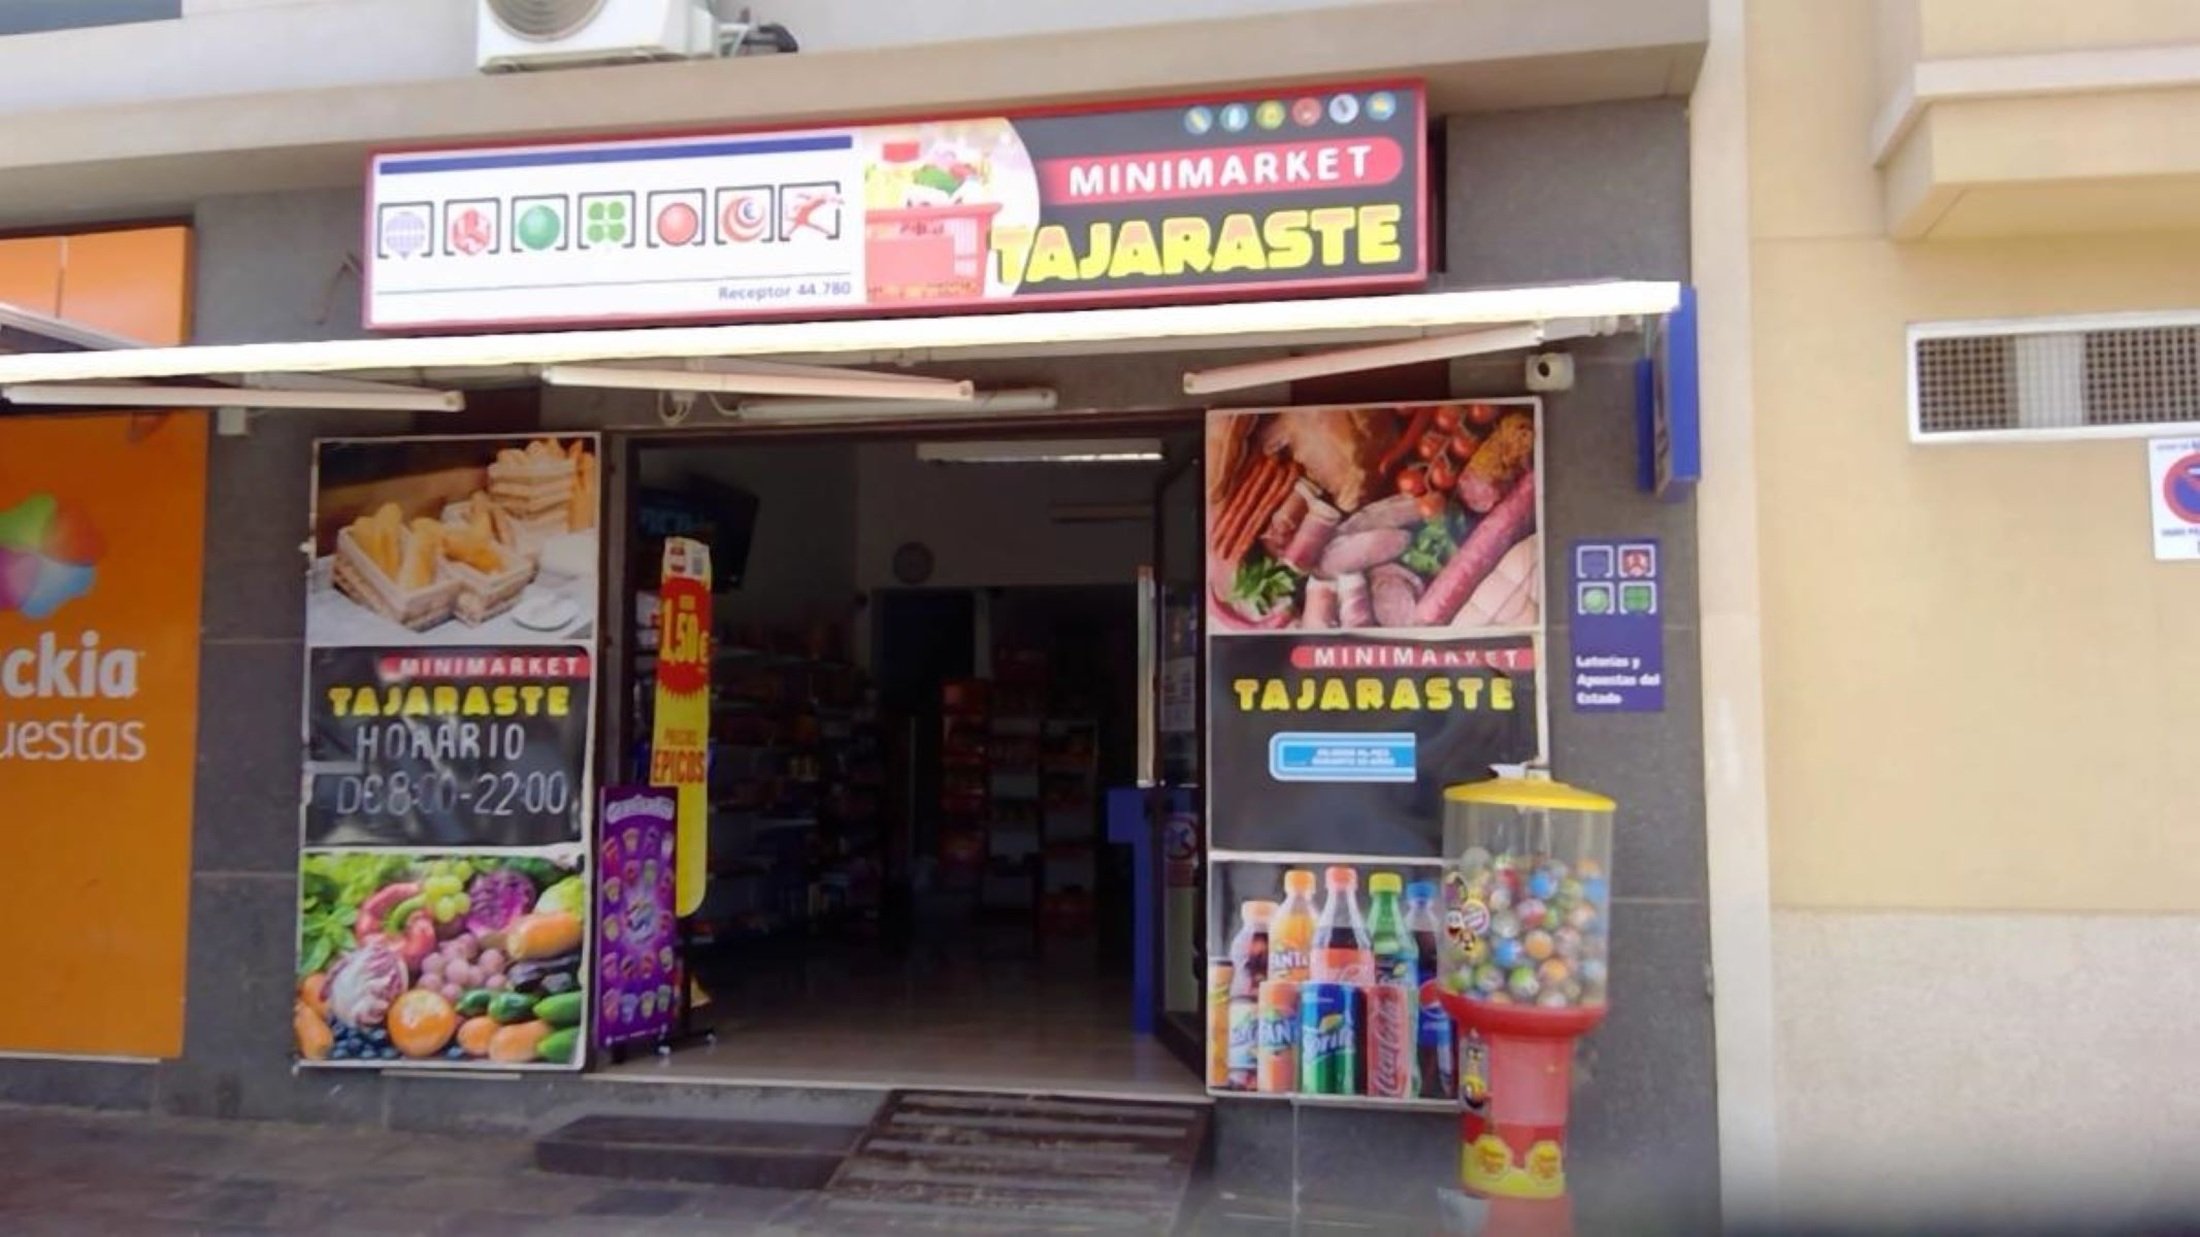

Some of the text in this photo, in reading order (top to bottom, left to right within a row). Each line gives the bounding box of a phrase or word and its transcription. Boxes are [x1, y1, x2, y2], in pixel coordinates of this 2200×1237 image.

[1069, 144, 1373, 197] MINIMARKET
[990, 204, 1401, 286] TAJARASTE
[719, 283, 791, 301] Receptor
[402, 656, 580, 678] MINIMARKET
[1576, 673, 1661, 688] Apuestas del
[328, 685, 570, 717] TAJARASTE
[1234, 678, 1514, 711] TAJARASTE
[1576, 692, 1622, 705] Estado
